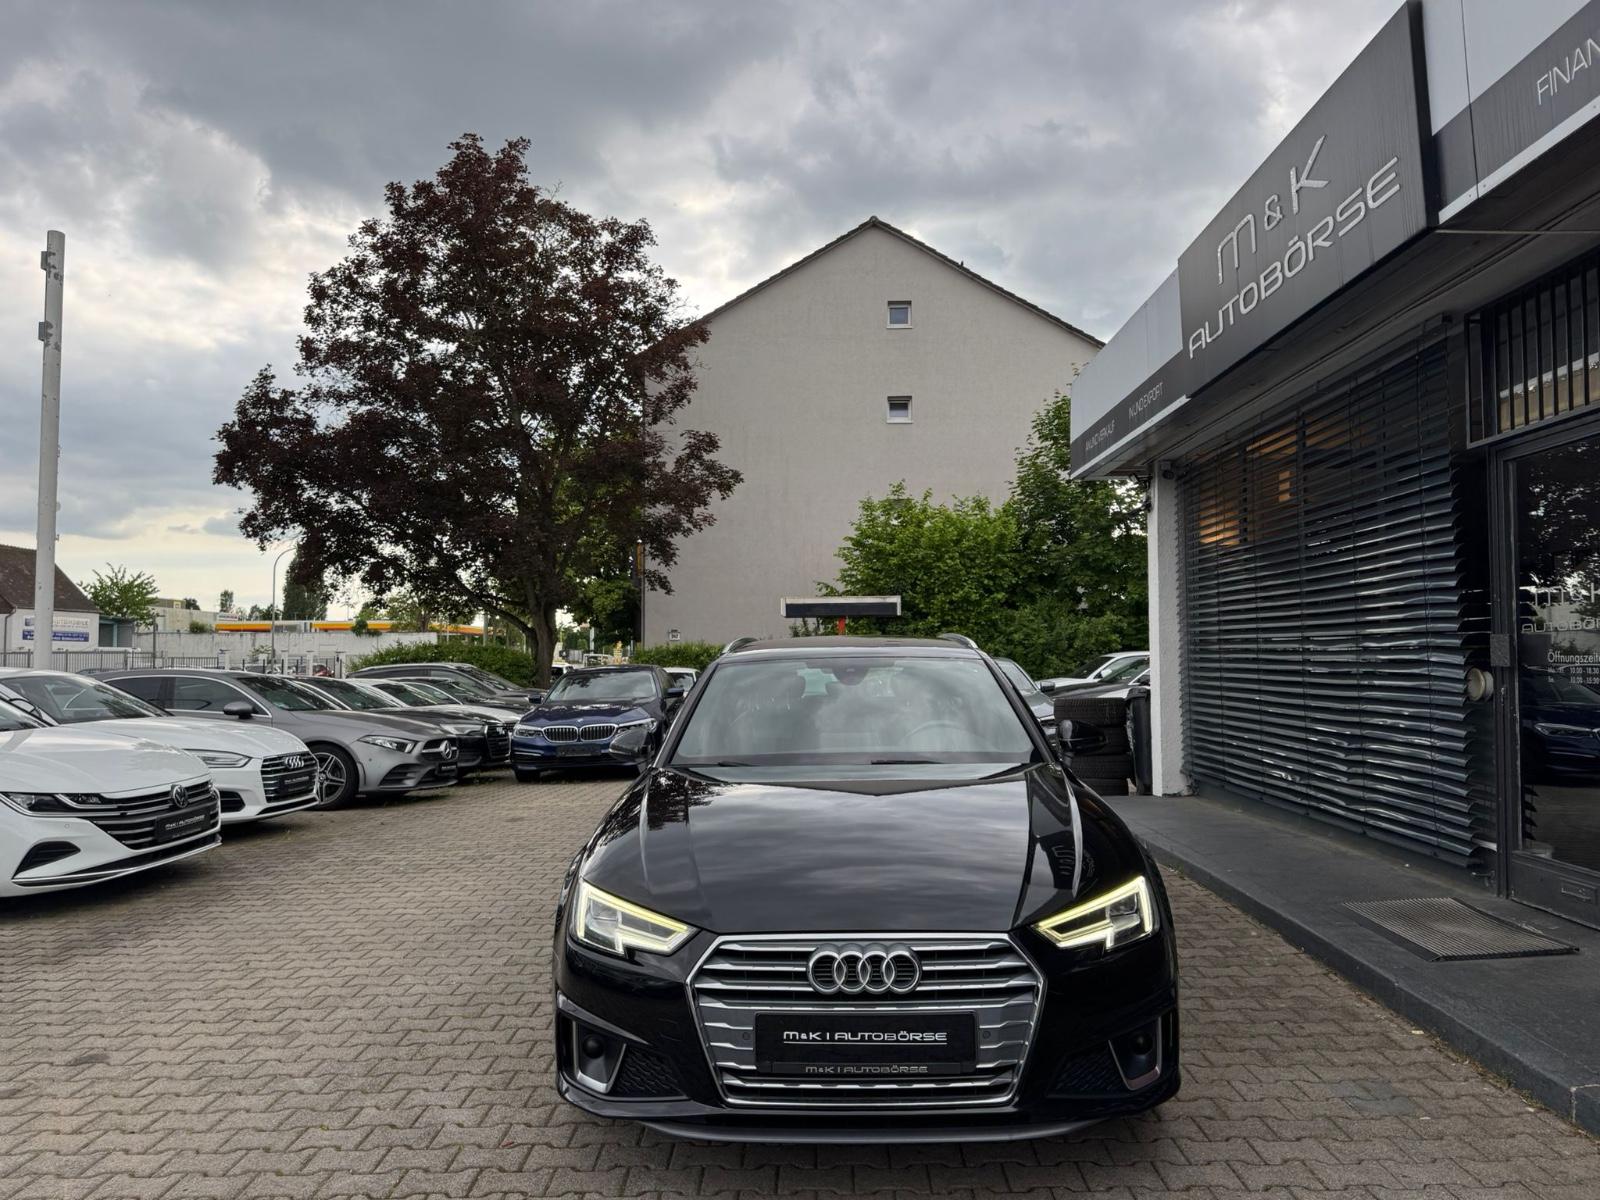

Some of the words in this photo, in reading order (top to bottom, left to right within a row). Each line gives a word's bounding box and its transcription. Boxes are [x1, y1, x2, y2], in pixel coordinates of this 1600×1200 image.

[1264, 194, 1283, 231] &
[1290, 135, 1330, 215] K
[1189, 156, 1401, 360] AUTOBÖRSE
[834, 1030, 948, 1041] AUTOBÖRSE
[844, 1064, 928, 1073] AUTOBÖRSE
